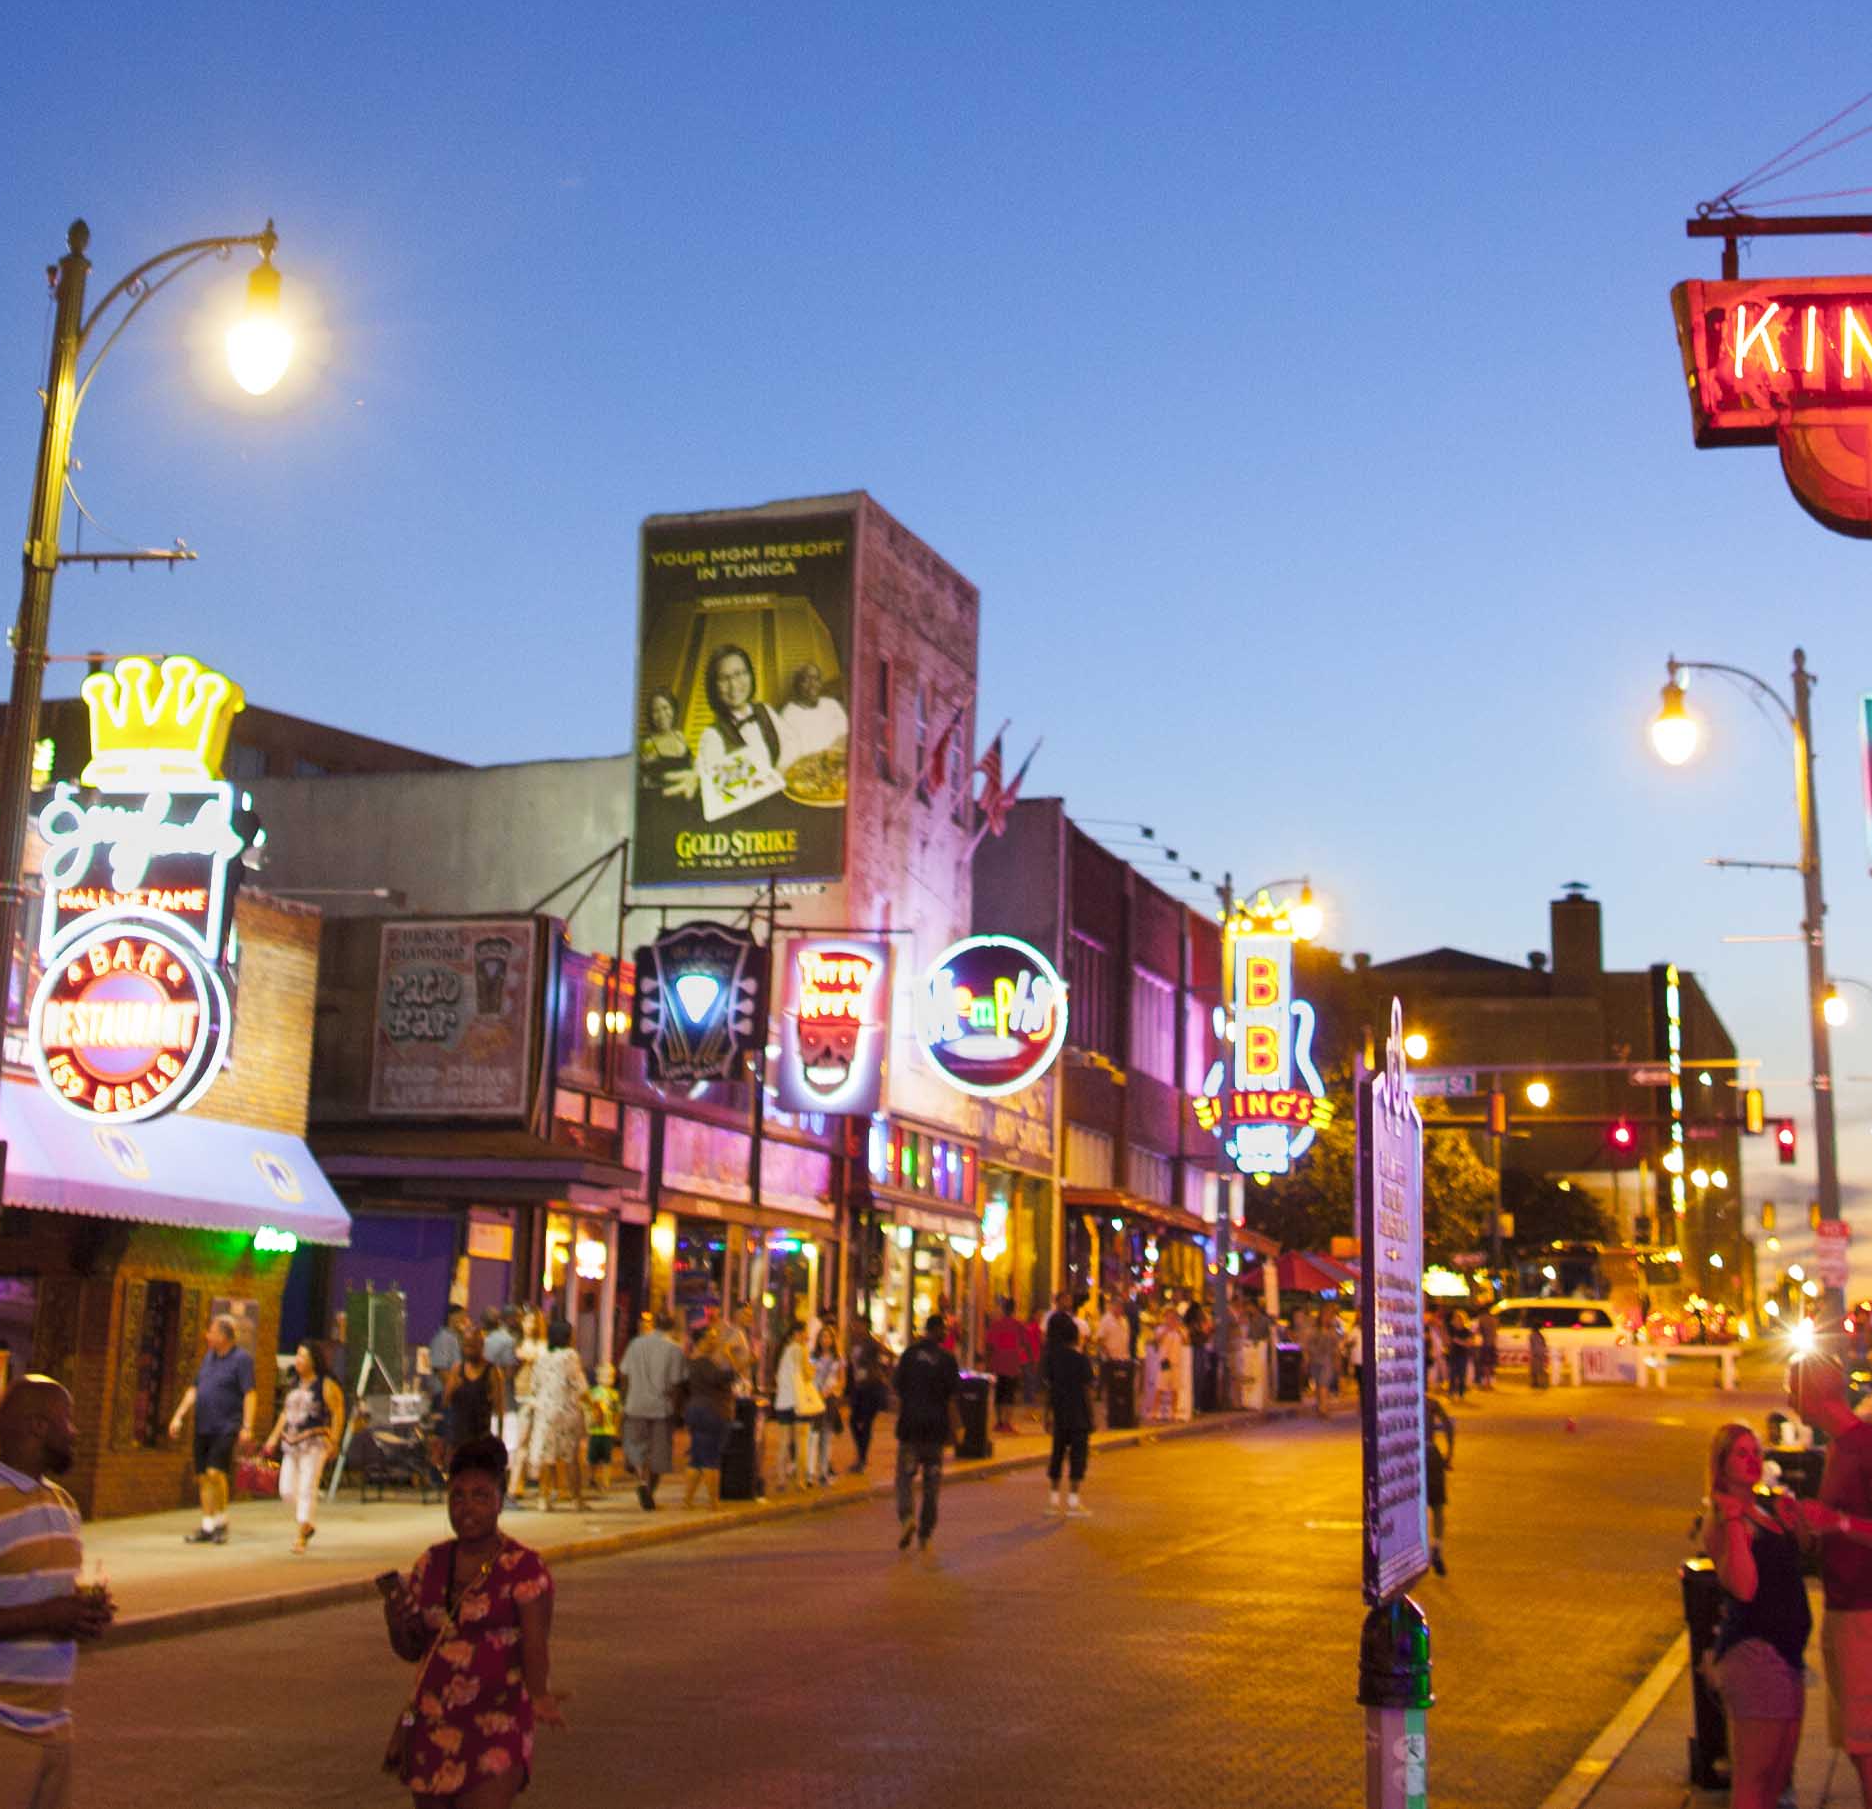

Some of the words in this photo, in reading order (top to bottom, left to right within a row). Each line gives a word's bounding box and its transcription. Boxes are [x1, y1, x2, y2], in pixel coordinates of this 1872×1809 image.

[652, 549, 705, 566] YOUR
[710, 546, 760, 562] MGM
[764, 540, 845, 558] RESORT
[696, 567, 717, 581] IN
[724, 561, 798, 579] TUNICA
[675, 830, 730, 858] GOLD
[730, 829, 799, 857] STRIKE
[148, 888, 206, 911] FAME
[89, 939, 165, 977] BAR
[1246, 957, 1278, 1007] B
[1246, 1025, 1278, 1075] B
[47, 1053, 86, 1098] 159
